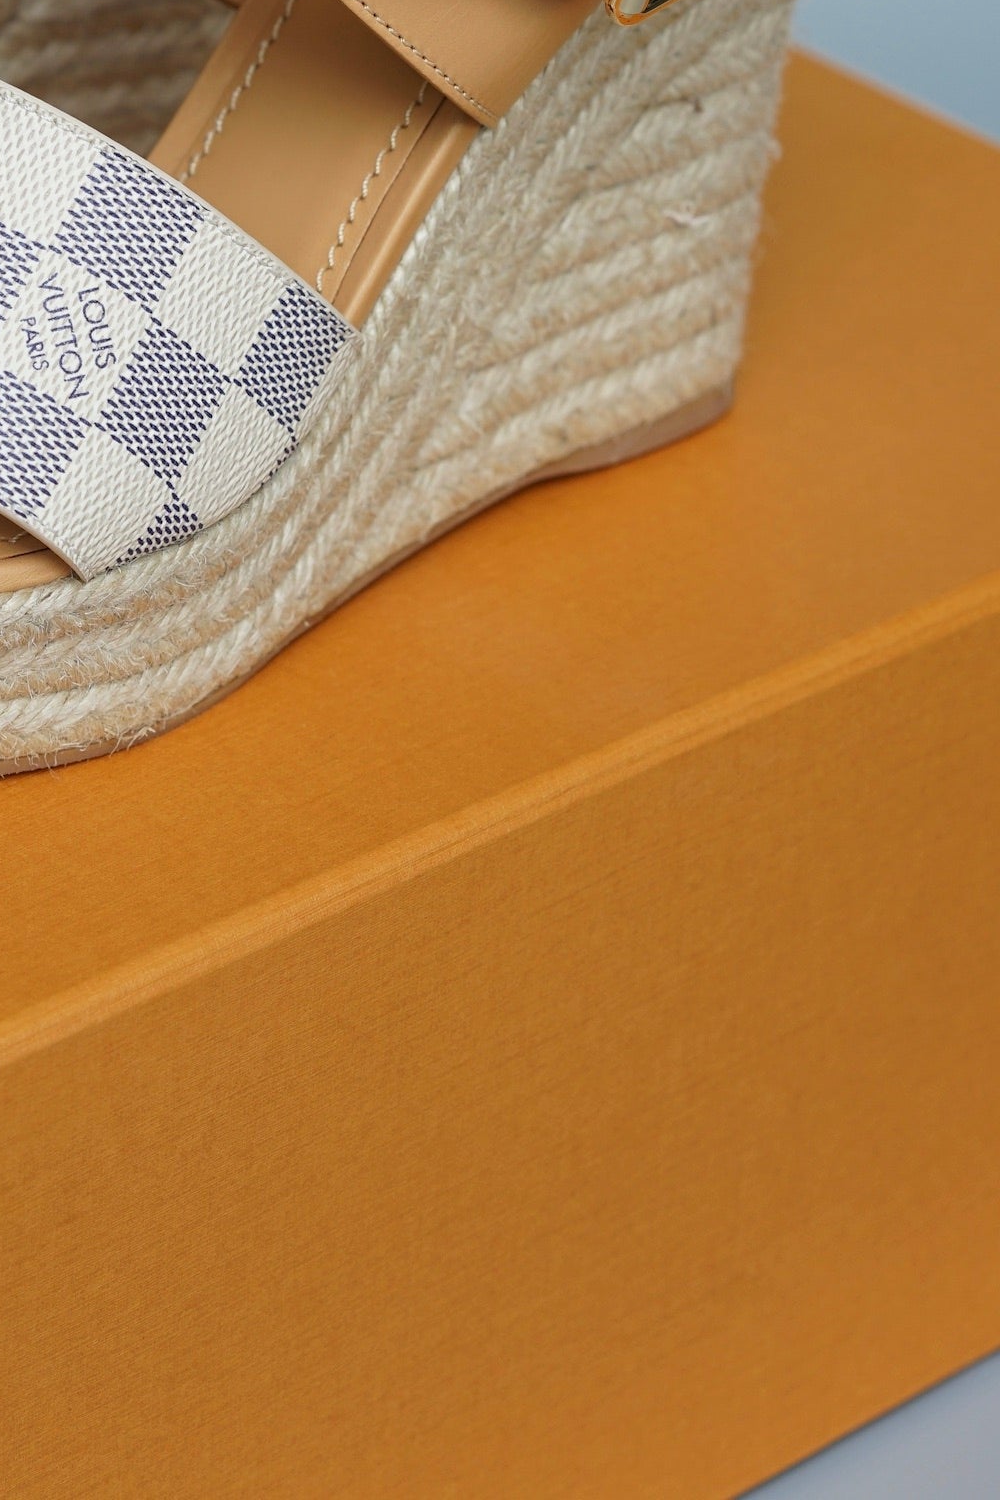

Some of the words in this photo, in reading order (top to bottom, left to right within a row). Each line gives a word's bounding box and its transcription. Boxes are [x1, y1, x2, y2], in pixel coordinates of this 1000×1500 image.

[20, 316, 50, 371] PARIS
[38, 272, 90, 399] VUITTON
[77, 286, 116, 369] LOUIS
